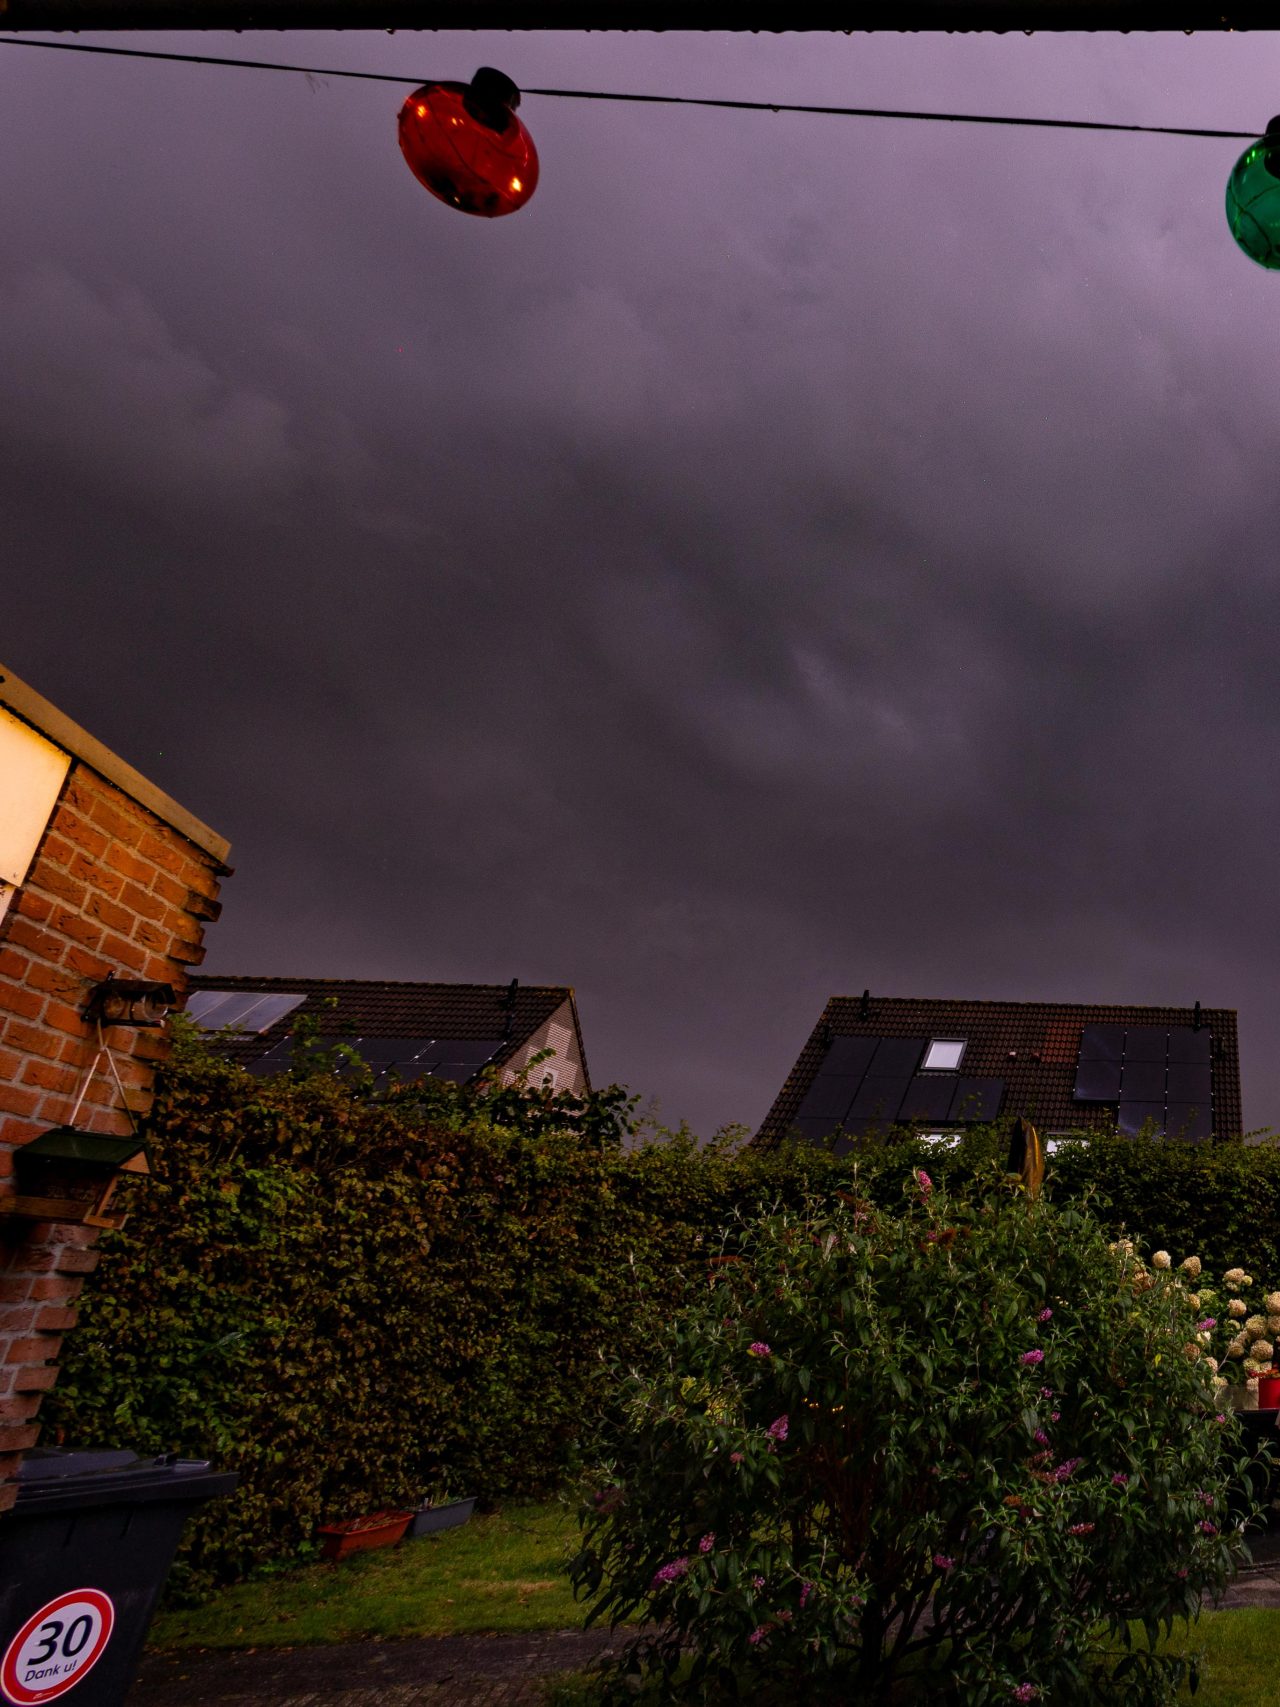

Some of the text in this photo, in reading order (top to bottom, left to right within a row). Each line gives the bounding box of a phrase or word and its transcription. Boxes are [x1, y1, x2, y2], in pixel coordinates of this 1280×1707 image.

[27, 1614, 94, 1666] 30
[25, 1660, 77, 1682] Dank u!
